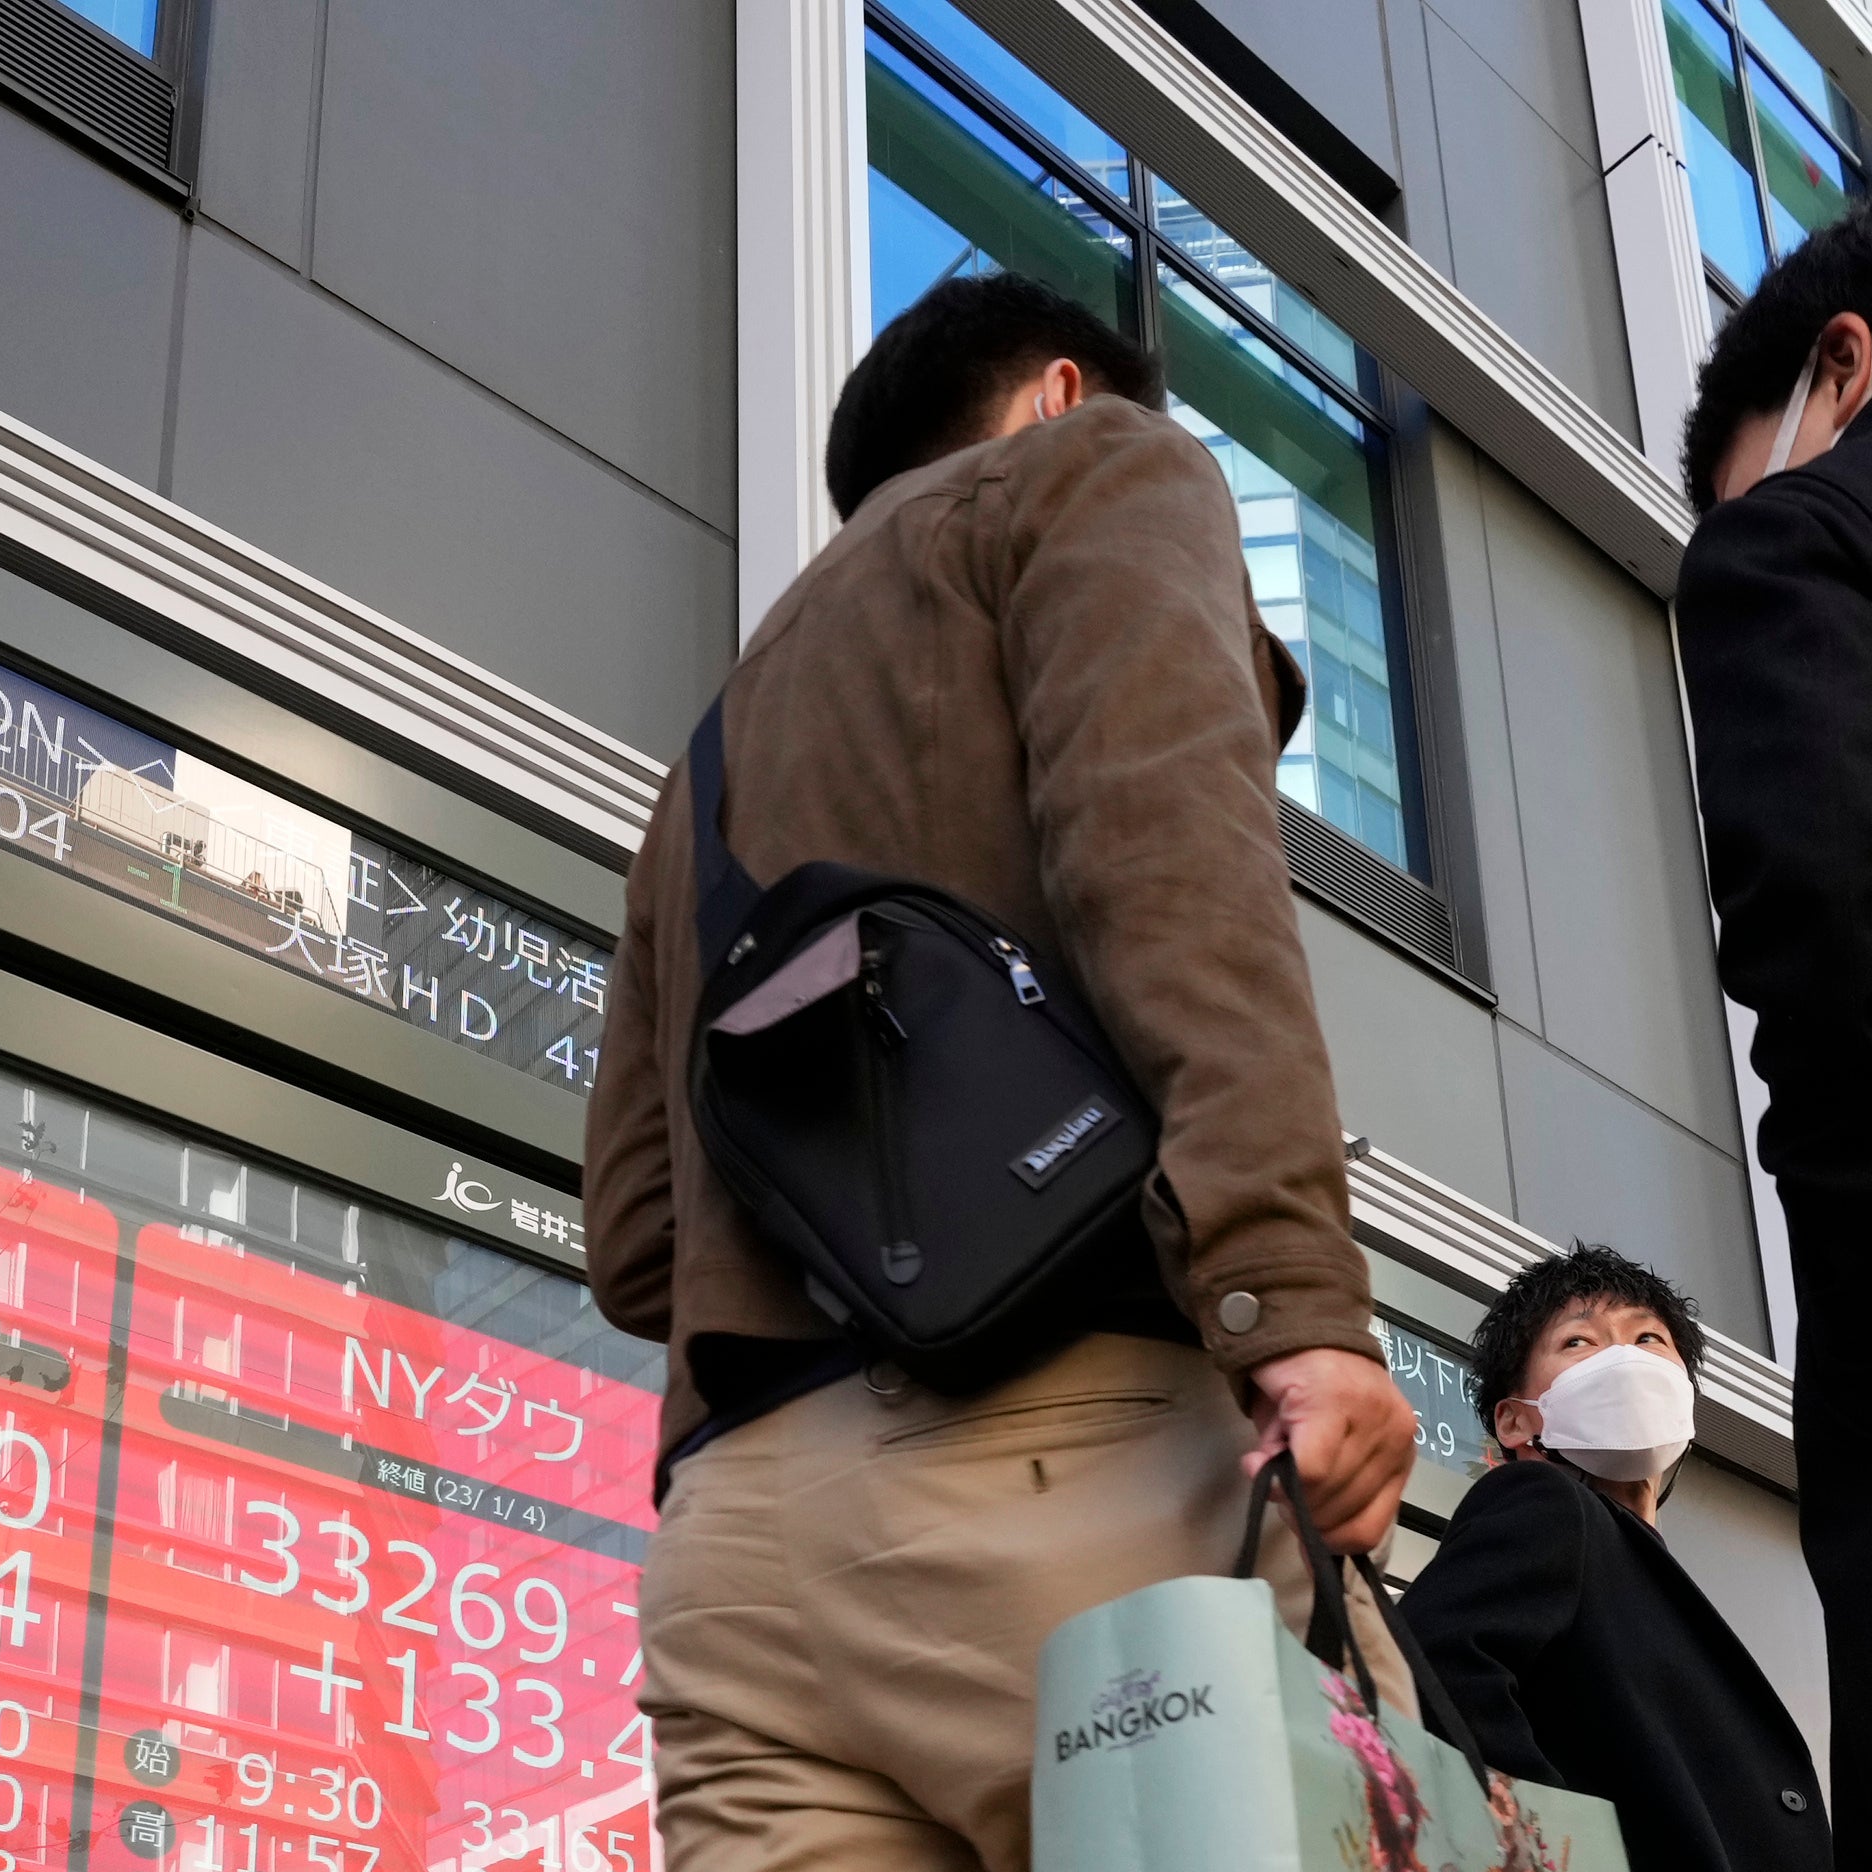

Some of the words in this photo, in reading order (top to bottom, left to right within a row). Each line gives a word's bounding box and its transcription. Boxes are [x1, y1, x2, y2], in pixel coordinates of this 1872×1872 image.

[341, 1335, 584, 1463] NYダウ
[1054, 1684, 1216, 1763] BANGKOK
[134, 1737, 171, 1777] 始
[236, 1752, 384, 1831] 9:30
[130, 1808, 166, 1850] 高
